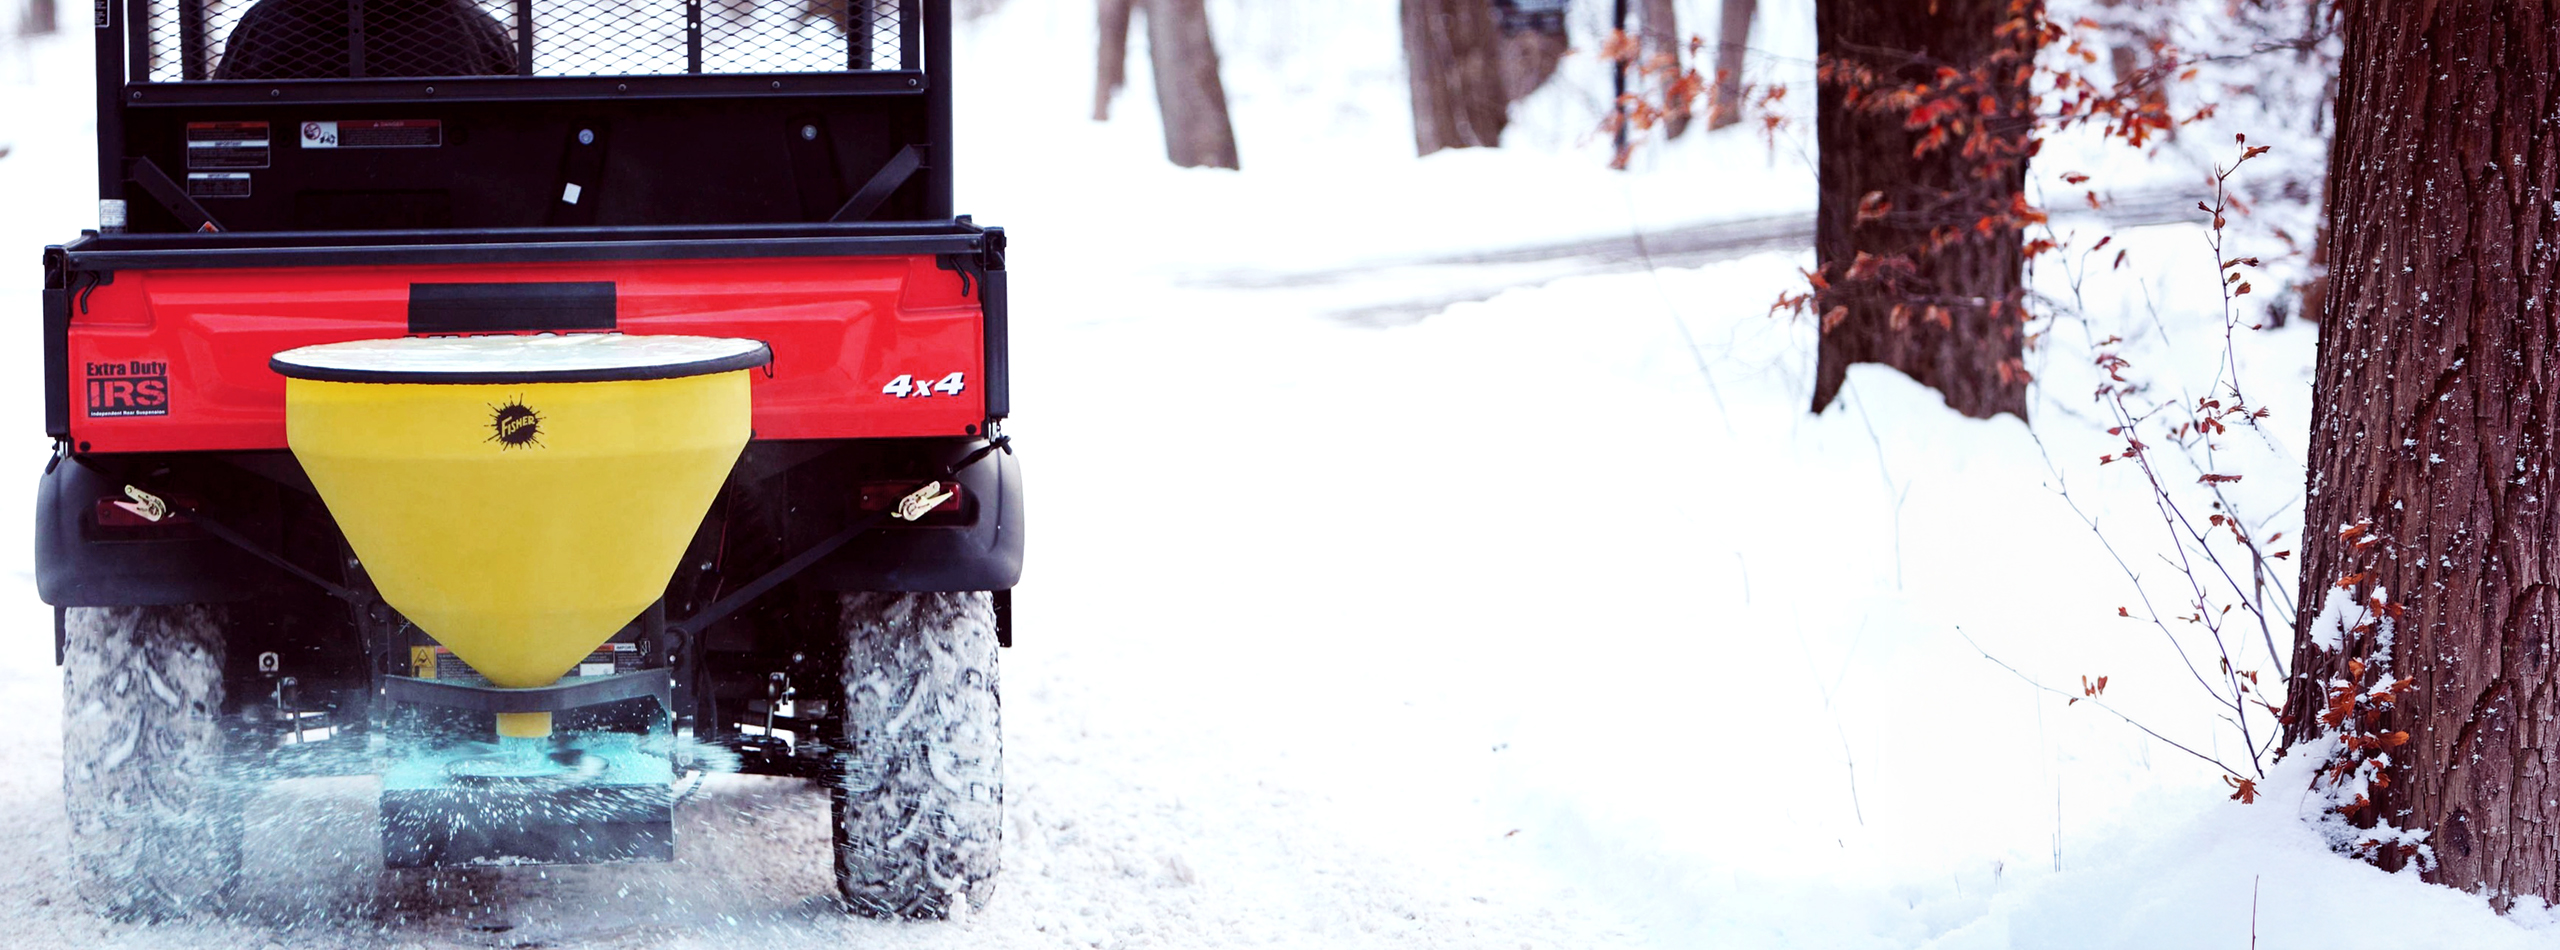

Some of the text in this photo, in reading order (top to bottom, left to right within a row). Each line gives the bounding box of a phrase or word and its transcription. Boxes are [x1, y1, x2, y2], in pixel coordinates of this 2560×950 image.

[87, 361, 167, 376] Extra Duty
[90, 380, 166, 407] IRS
[882, 371, 966, 399] 4x4
[501, 415, 536, 438] FISHER
